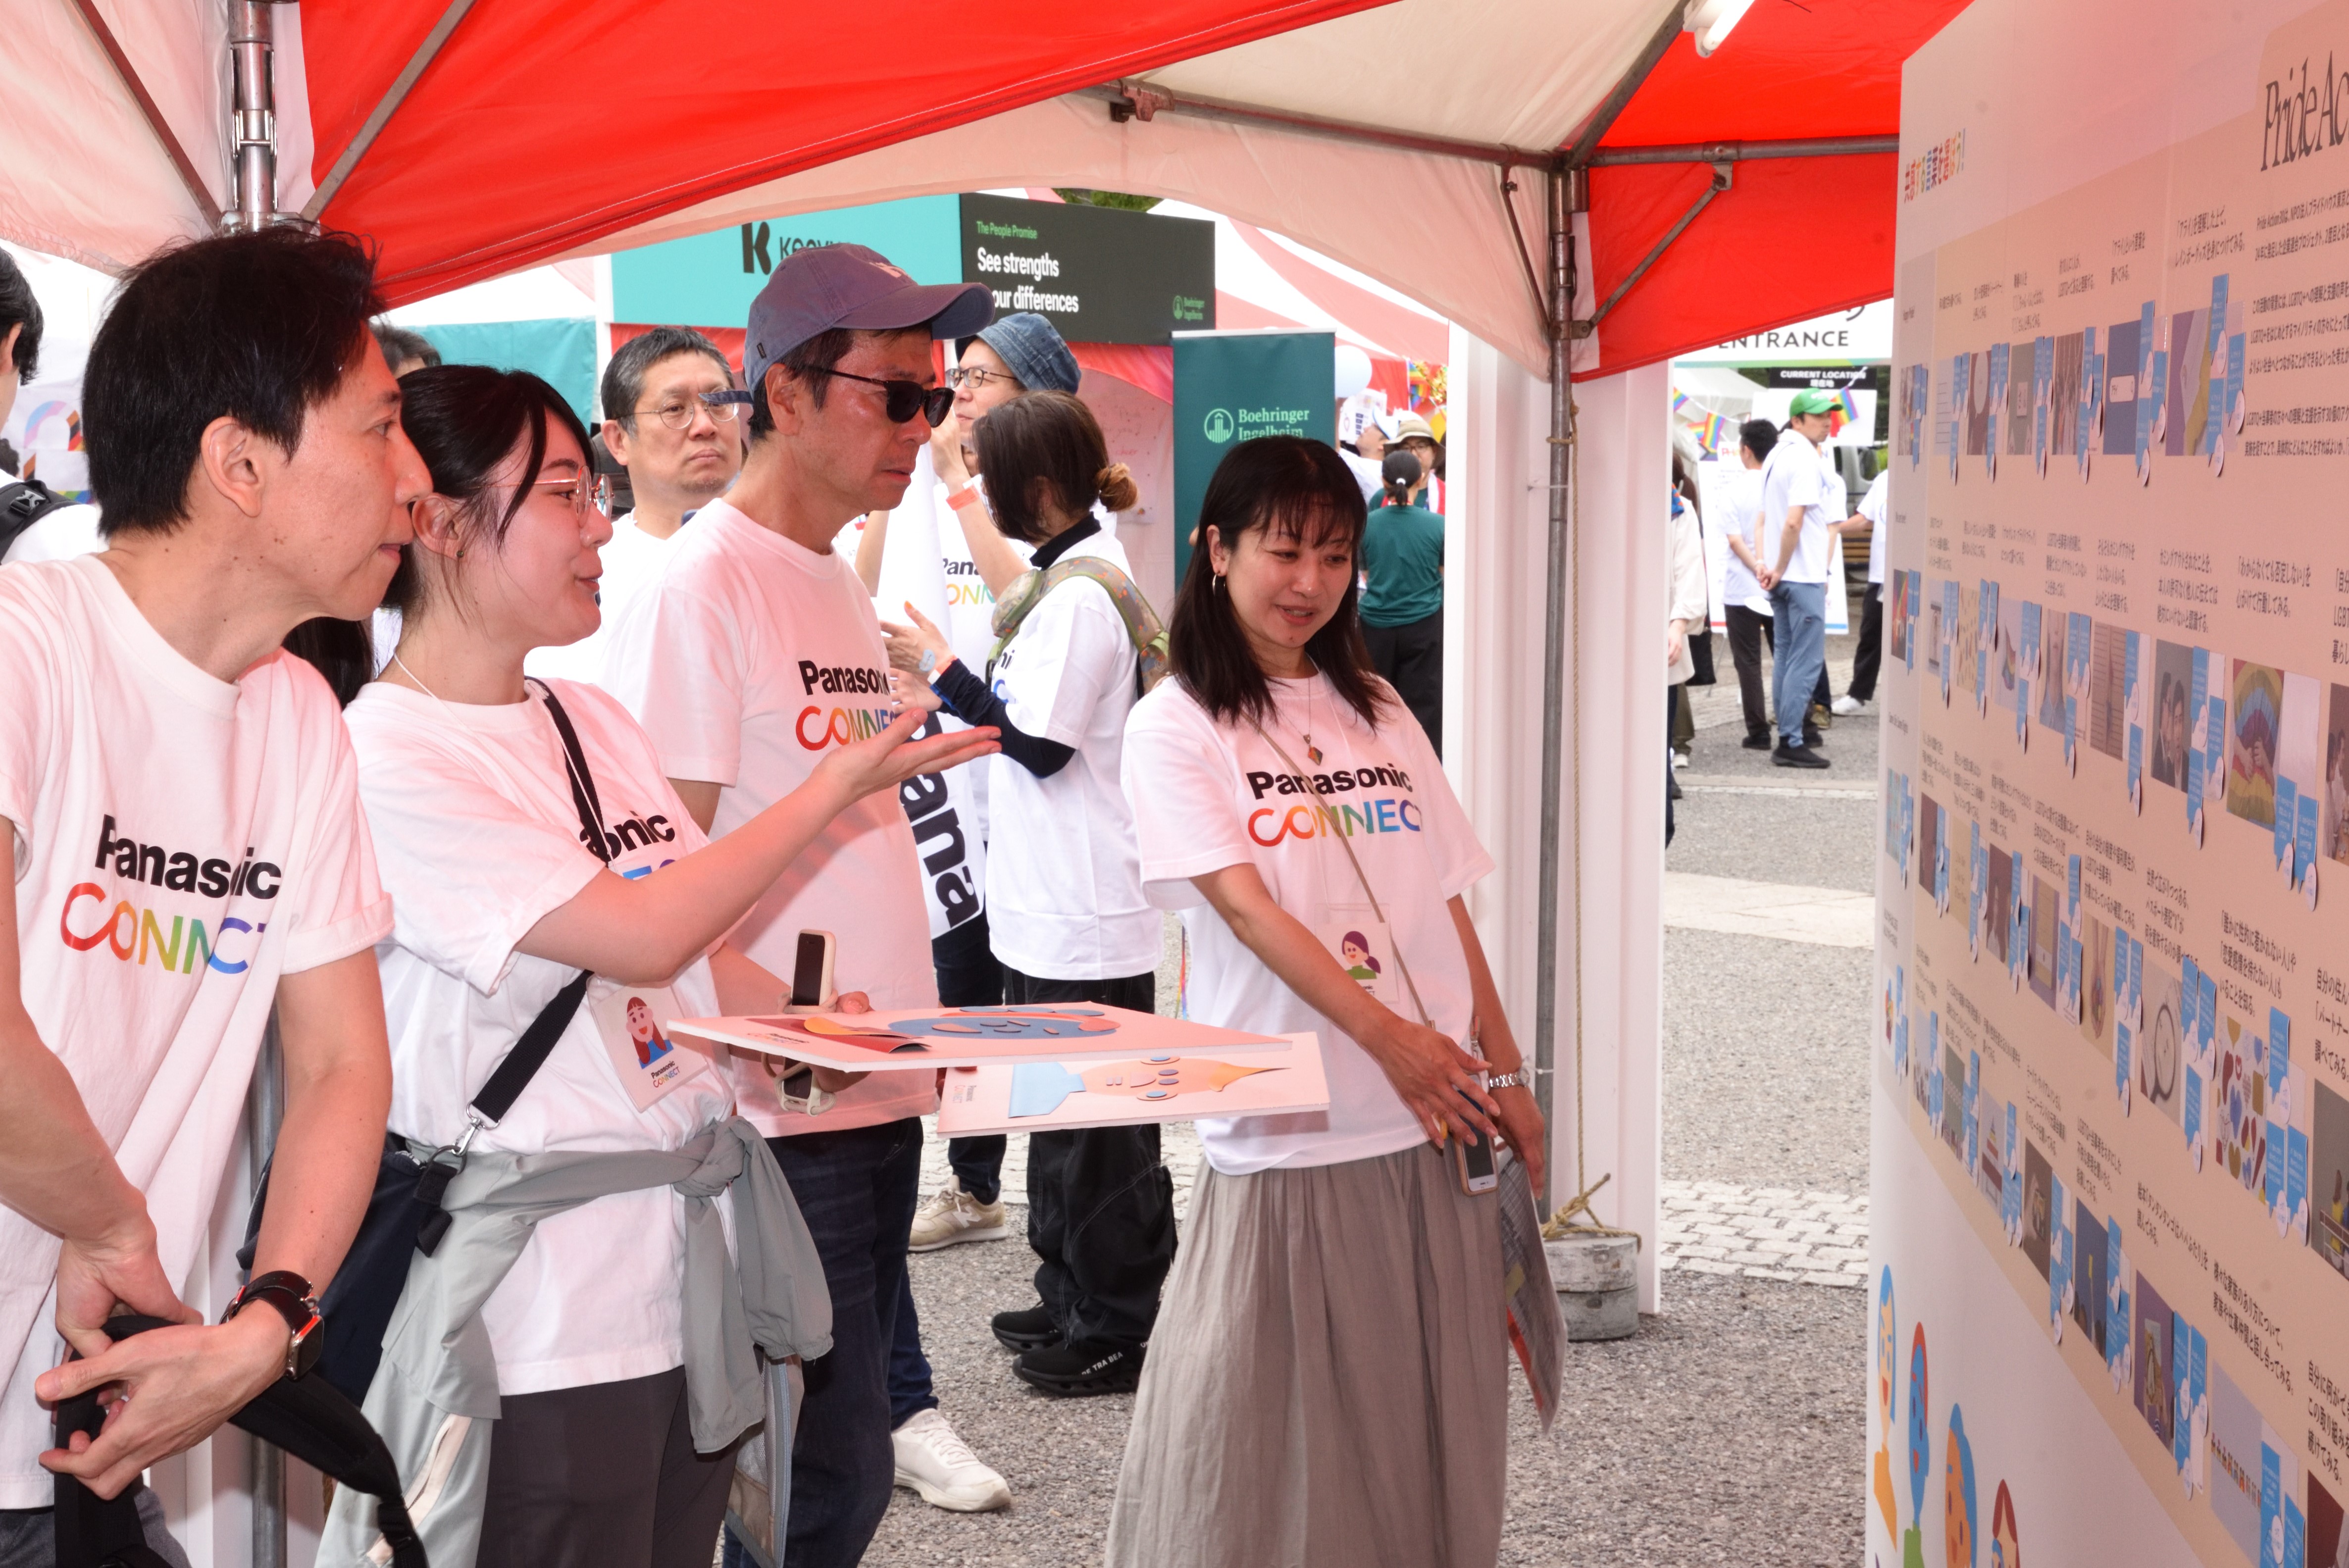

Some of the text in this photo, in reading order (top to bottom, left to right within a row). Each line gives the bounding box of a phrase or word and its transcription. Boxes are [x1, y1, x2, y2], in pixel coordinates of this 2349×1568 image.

[2260, 56, 2318, 172] Pride
[976, 221, 1038, 239] The People Promise
[977, 247, 1059, 281] See strengths
[1014, 285, 1079, 312] differences
[2251, 313, 2349, 344] LGBTQ+をはじめとするマイノリティの方々にとって
[1238, 407, 1310, 423] Boehringer
[1246, 763, 1413, 800] Panasonic
[1248, 799, 1423, 847] CONNEC
[95, 814, 281, 900] Panasic
[2317, 966, 2349, 1006] 自分の住ん
[651, 1060, 675, 1079] Panasonic
[653, 1066, 680, 1088] CONNECT
[2308, 1360, 2349, 1421] 自分に何がで
